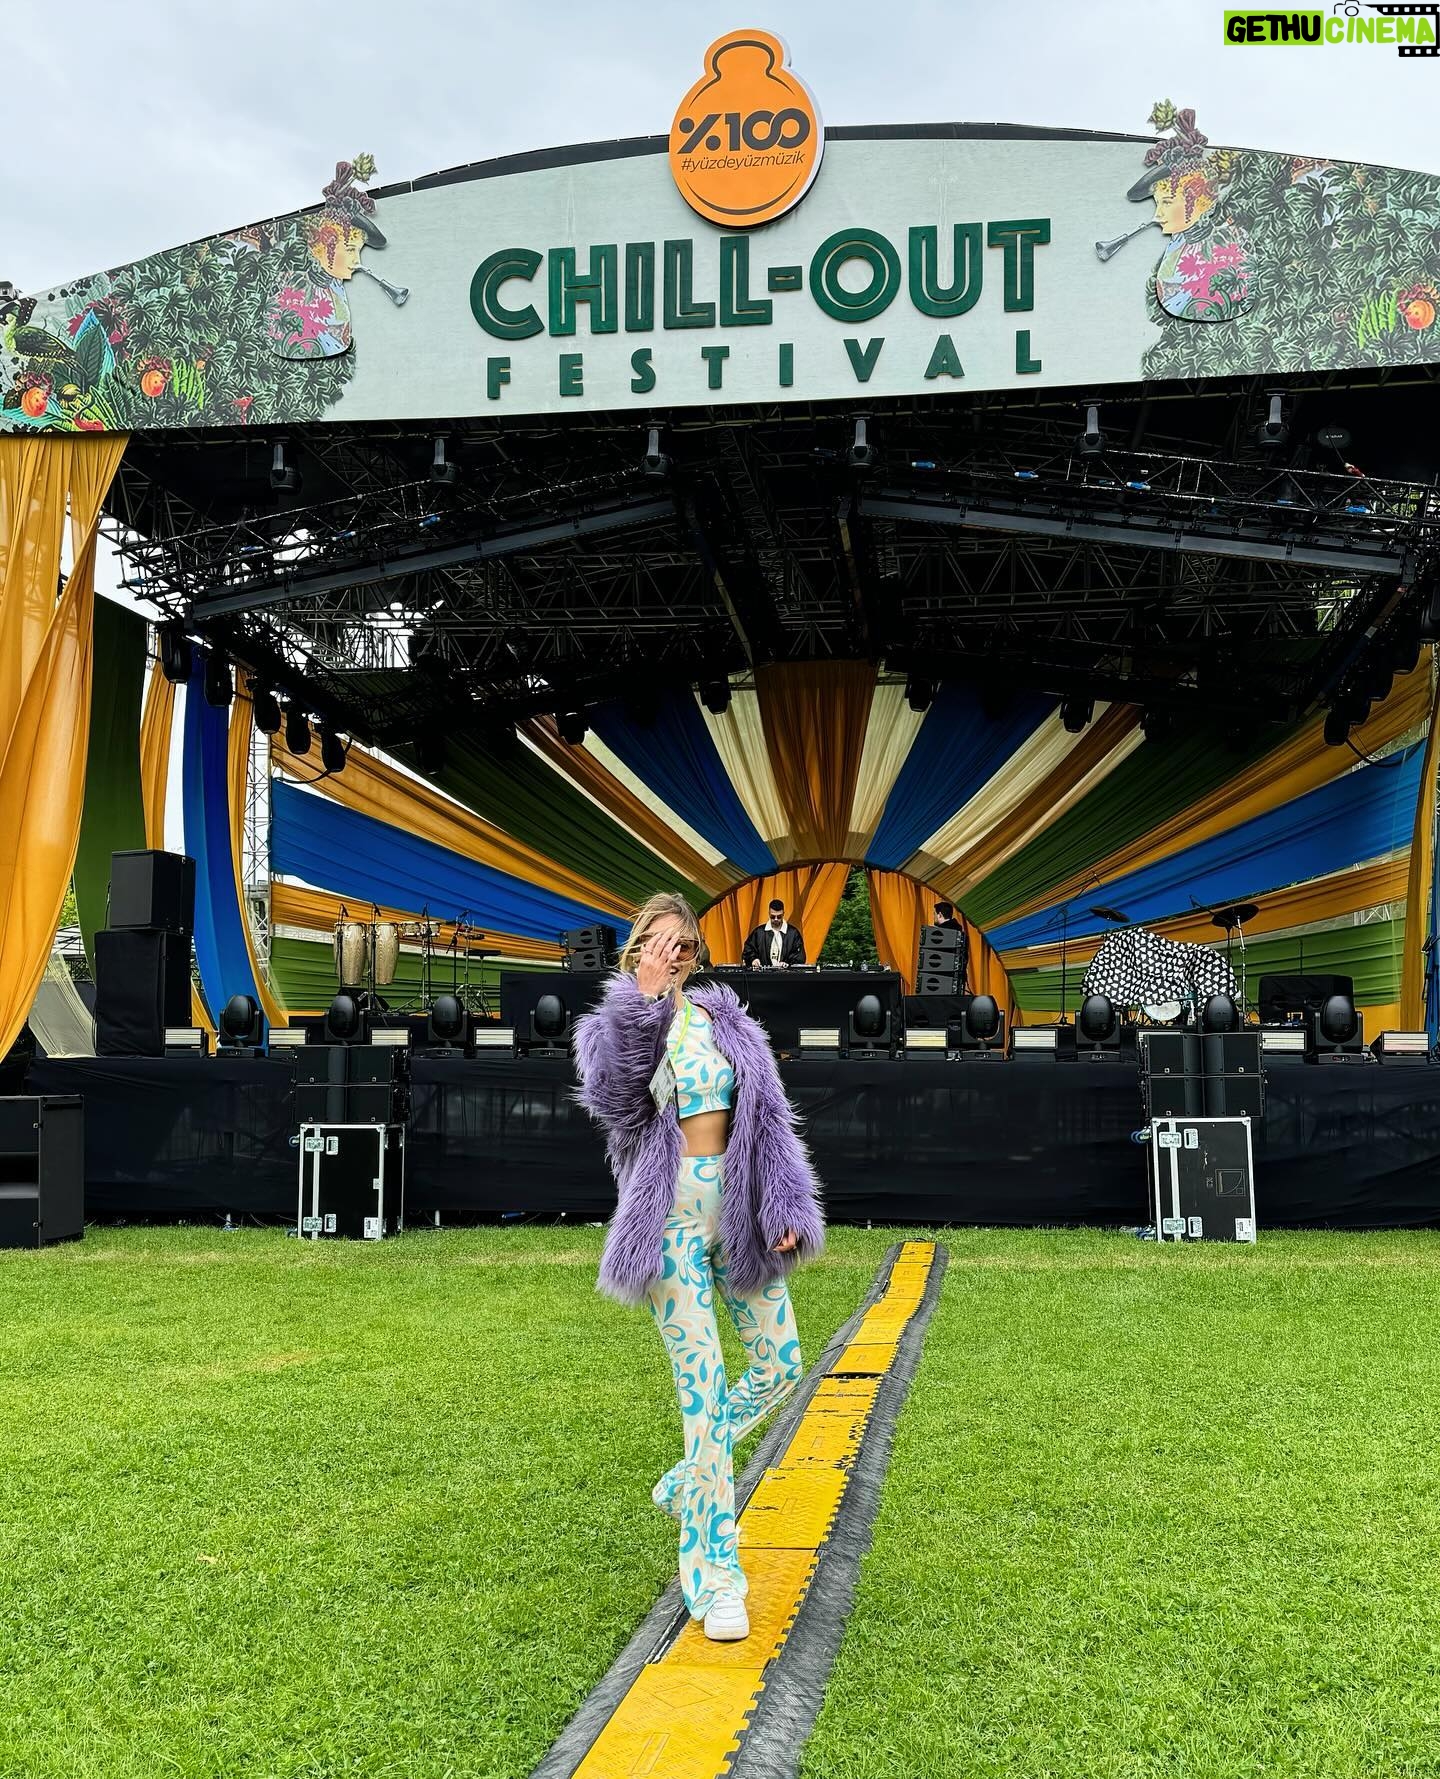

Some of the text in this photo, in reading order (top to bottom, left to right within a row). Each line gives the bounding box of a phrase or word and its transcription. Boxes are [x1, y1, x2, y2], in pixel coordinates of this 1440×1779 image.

[677, 107, 811, 155] %100
[681, 151, 806, 173] #yüzdeyüzmüzik
[469, 217, 1051, 340] CHILL-OUT
[486, 329, 1042, 400] FESTIVAL
